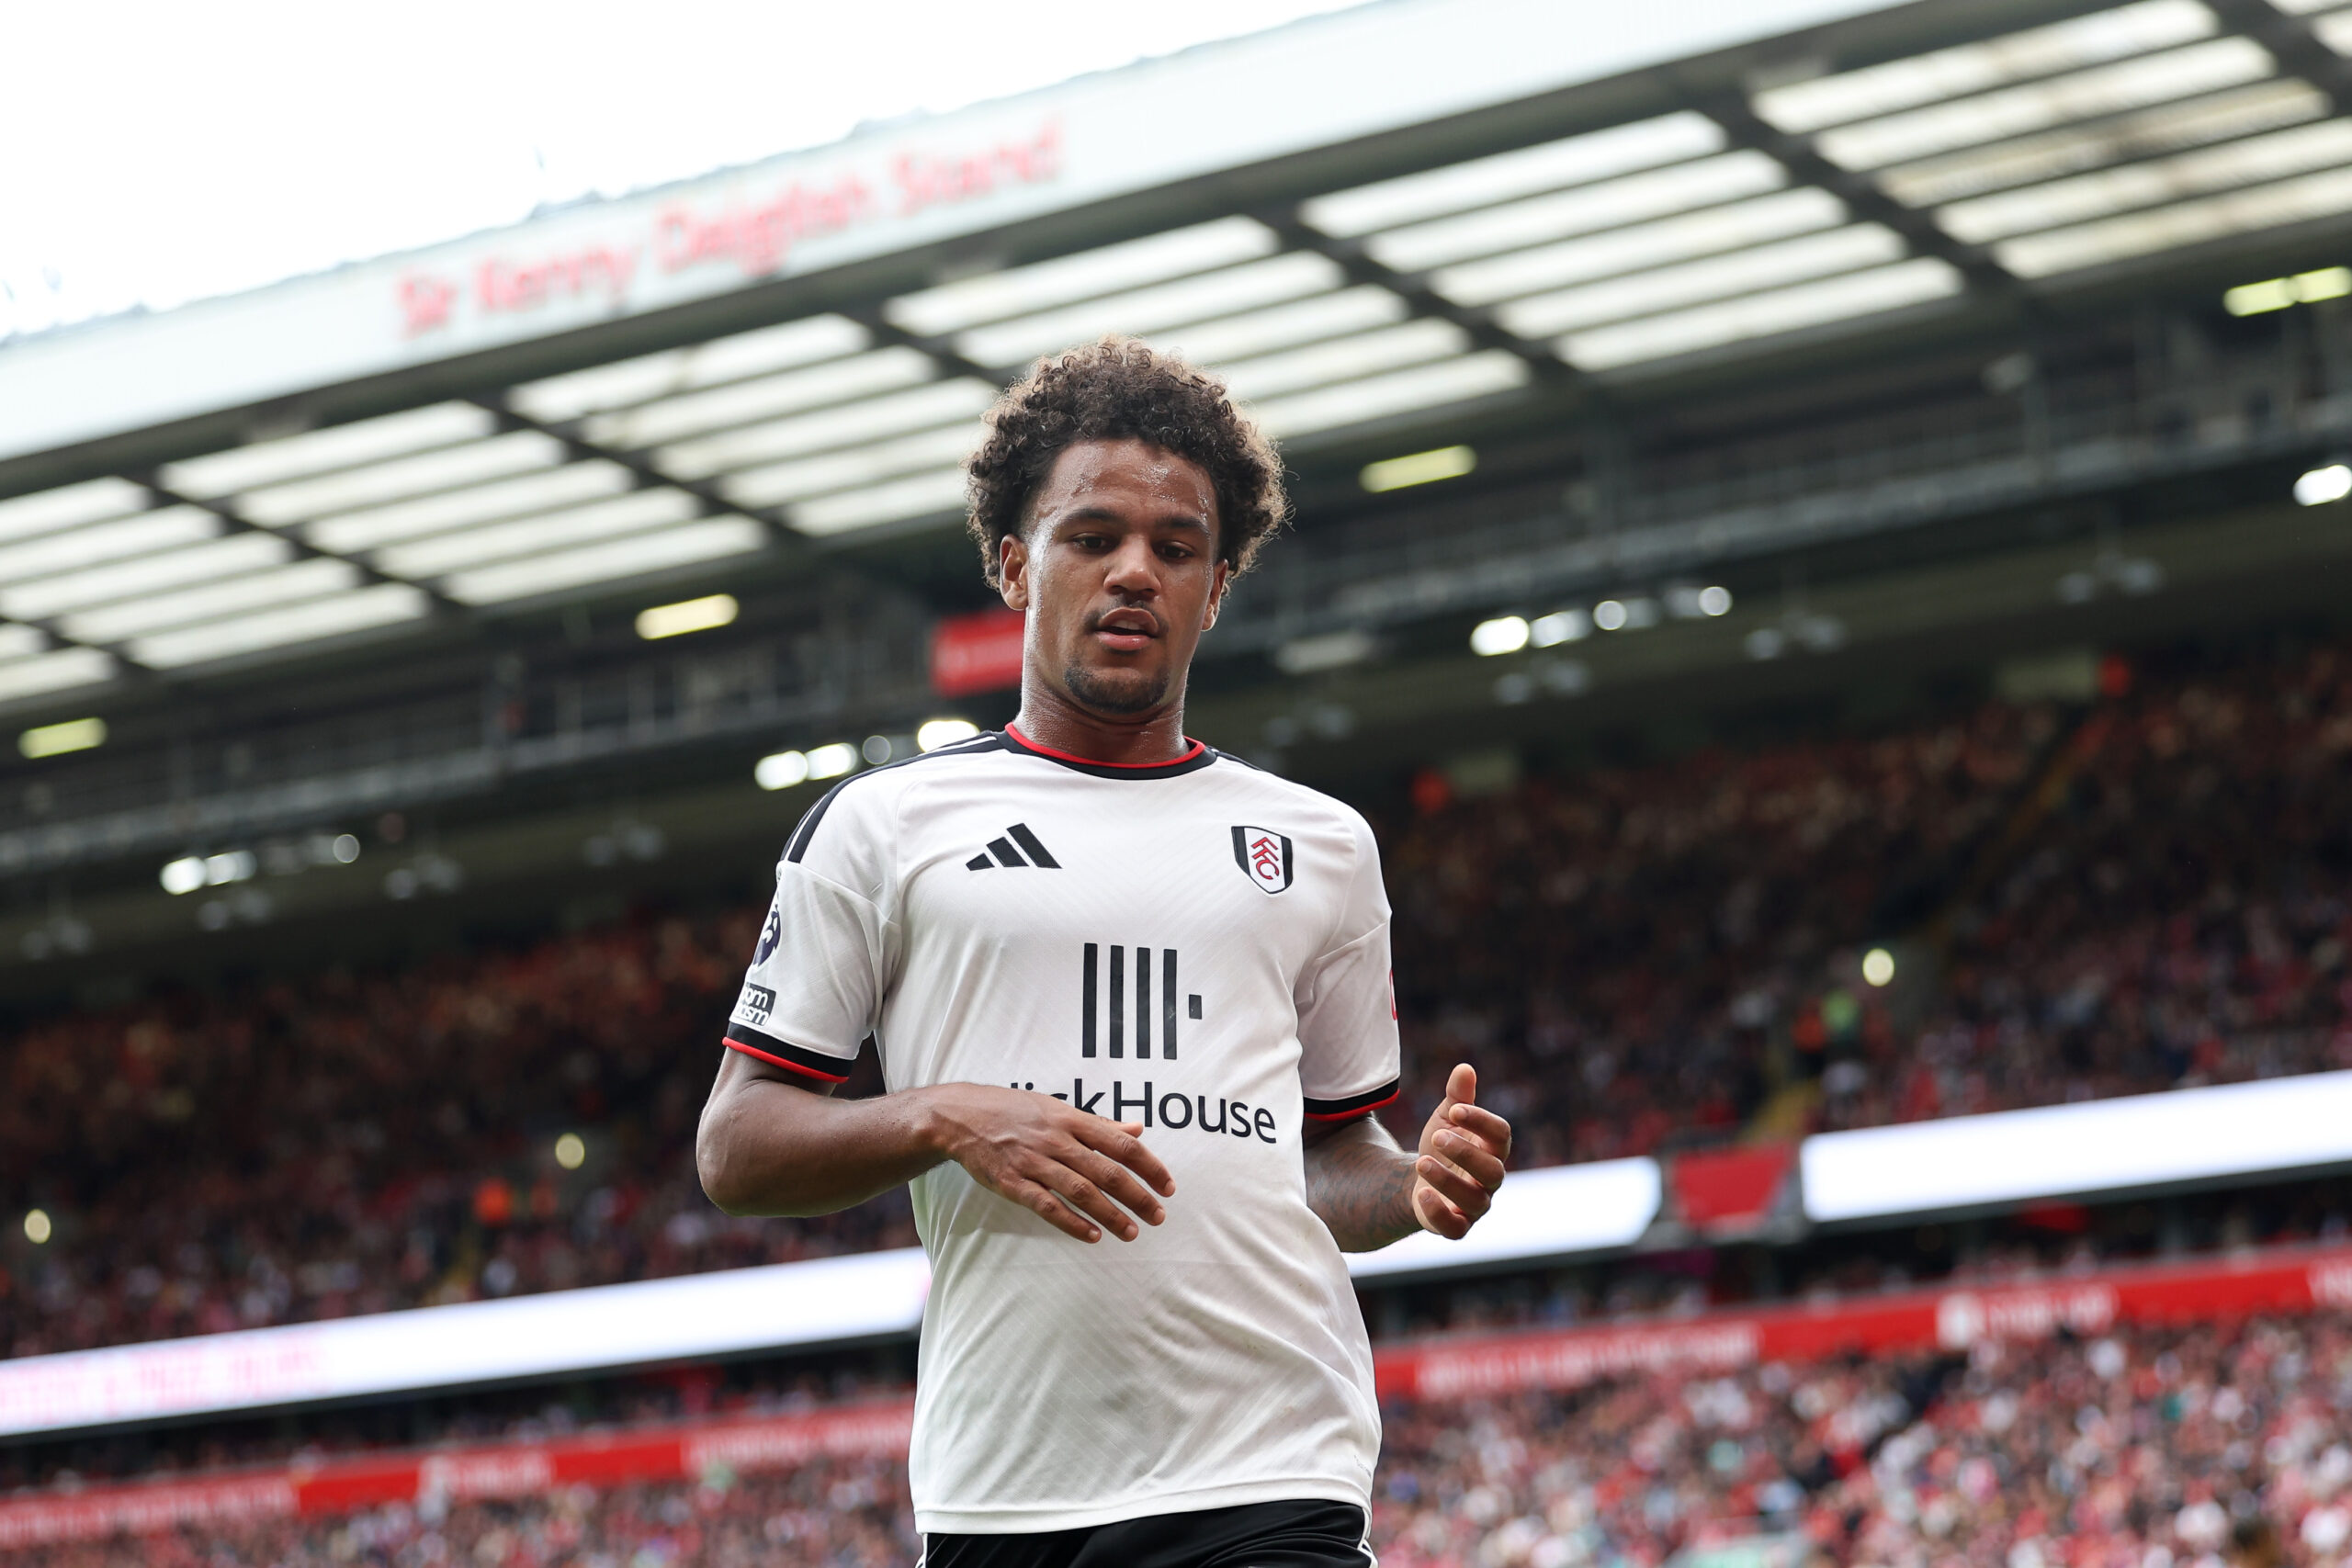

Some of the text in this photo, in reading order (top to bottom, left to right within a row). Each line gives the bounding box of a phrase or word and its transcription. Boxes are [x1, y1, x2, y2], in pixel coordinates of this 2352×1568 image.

[473, 243, 638, 313] Kenny
[892, 121, 1061, 215] Stand
[1250, 837, 1279, 880] FFC
